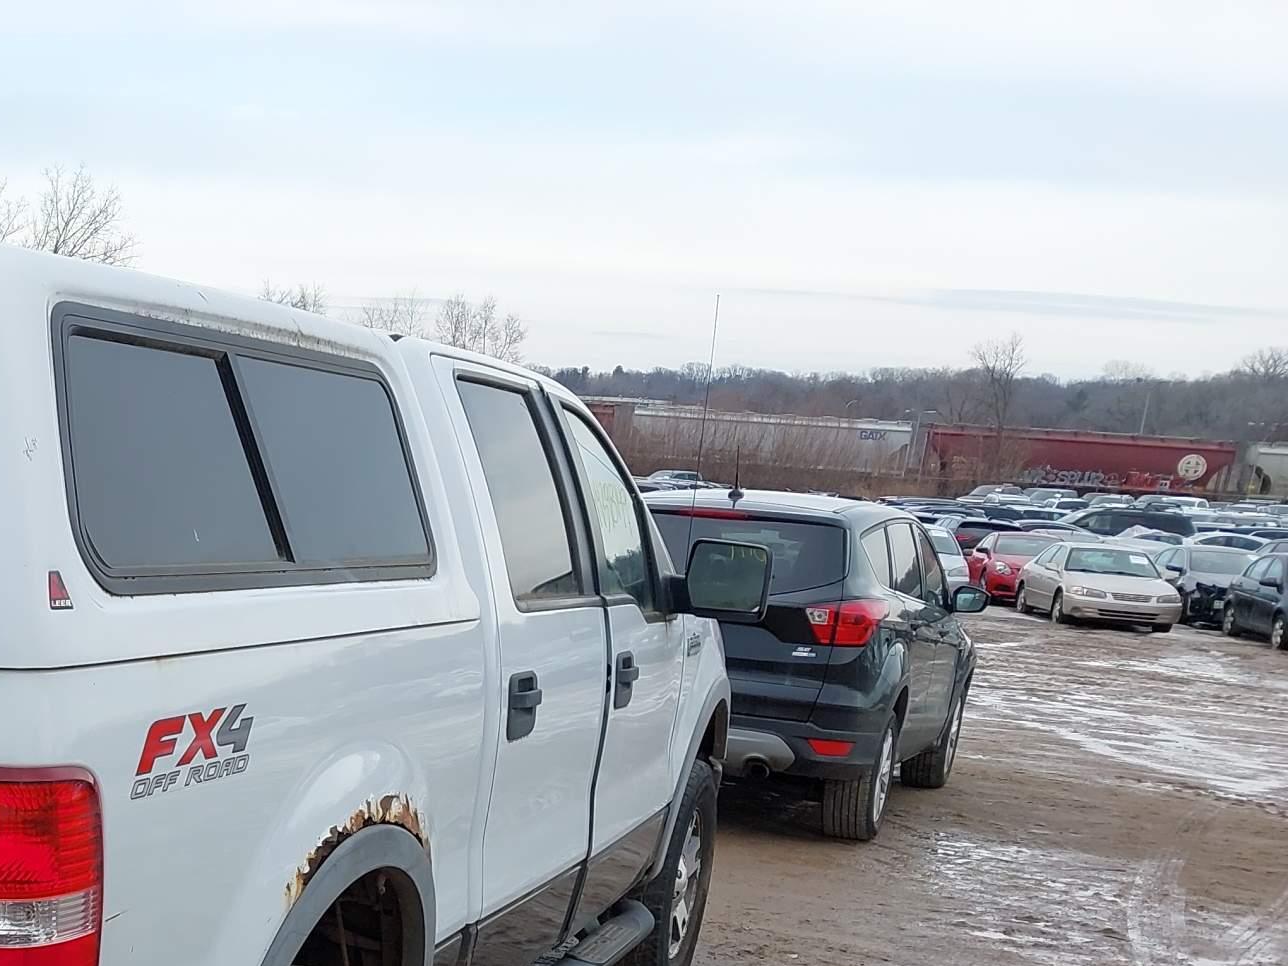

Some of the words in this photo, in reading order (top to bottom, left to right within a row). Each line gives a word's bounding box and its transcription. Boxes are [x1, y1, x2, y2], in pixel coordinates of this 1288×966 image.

[860, 431, 887, 441] GATX
[135, 703, 254, 776] FX4
[130, 770, 181, 800] OFF
[184, 754, 249, 787] ROAD
